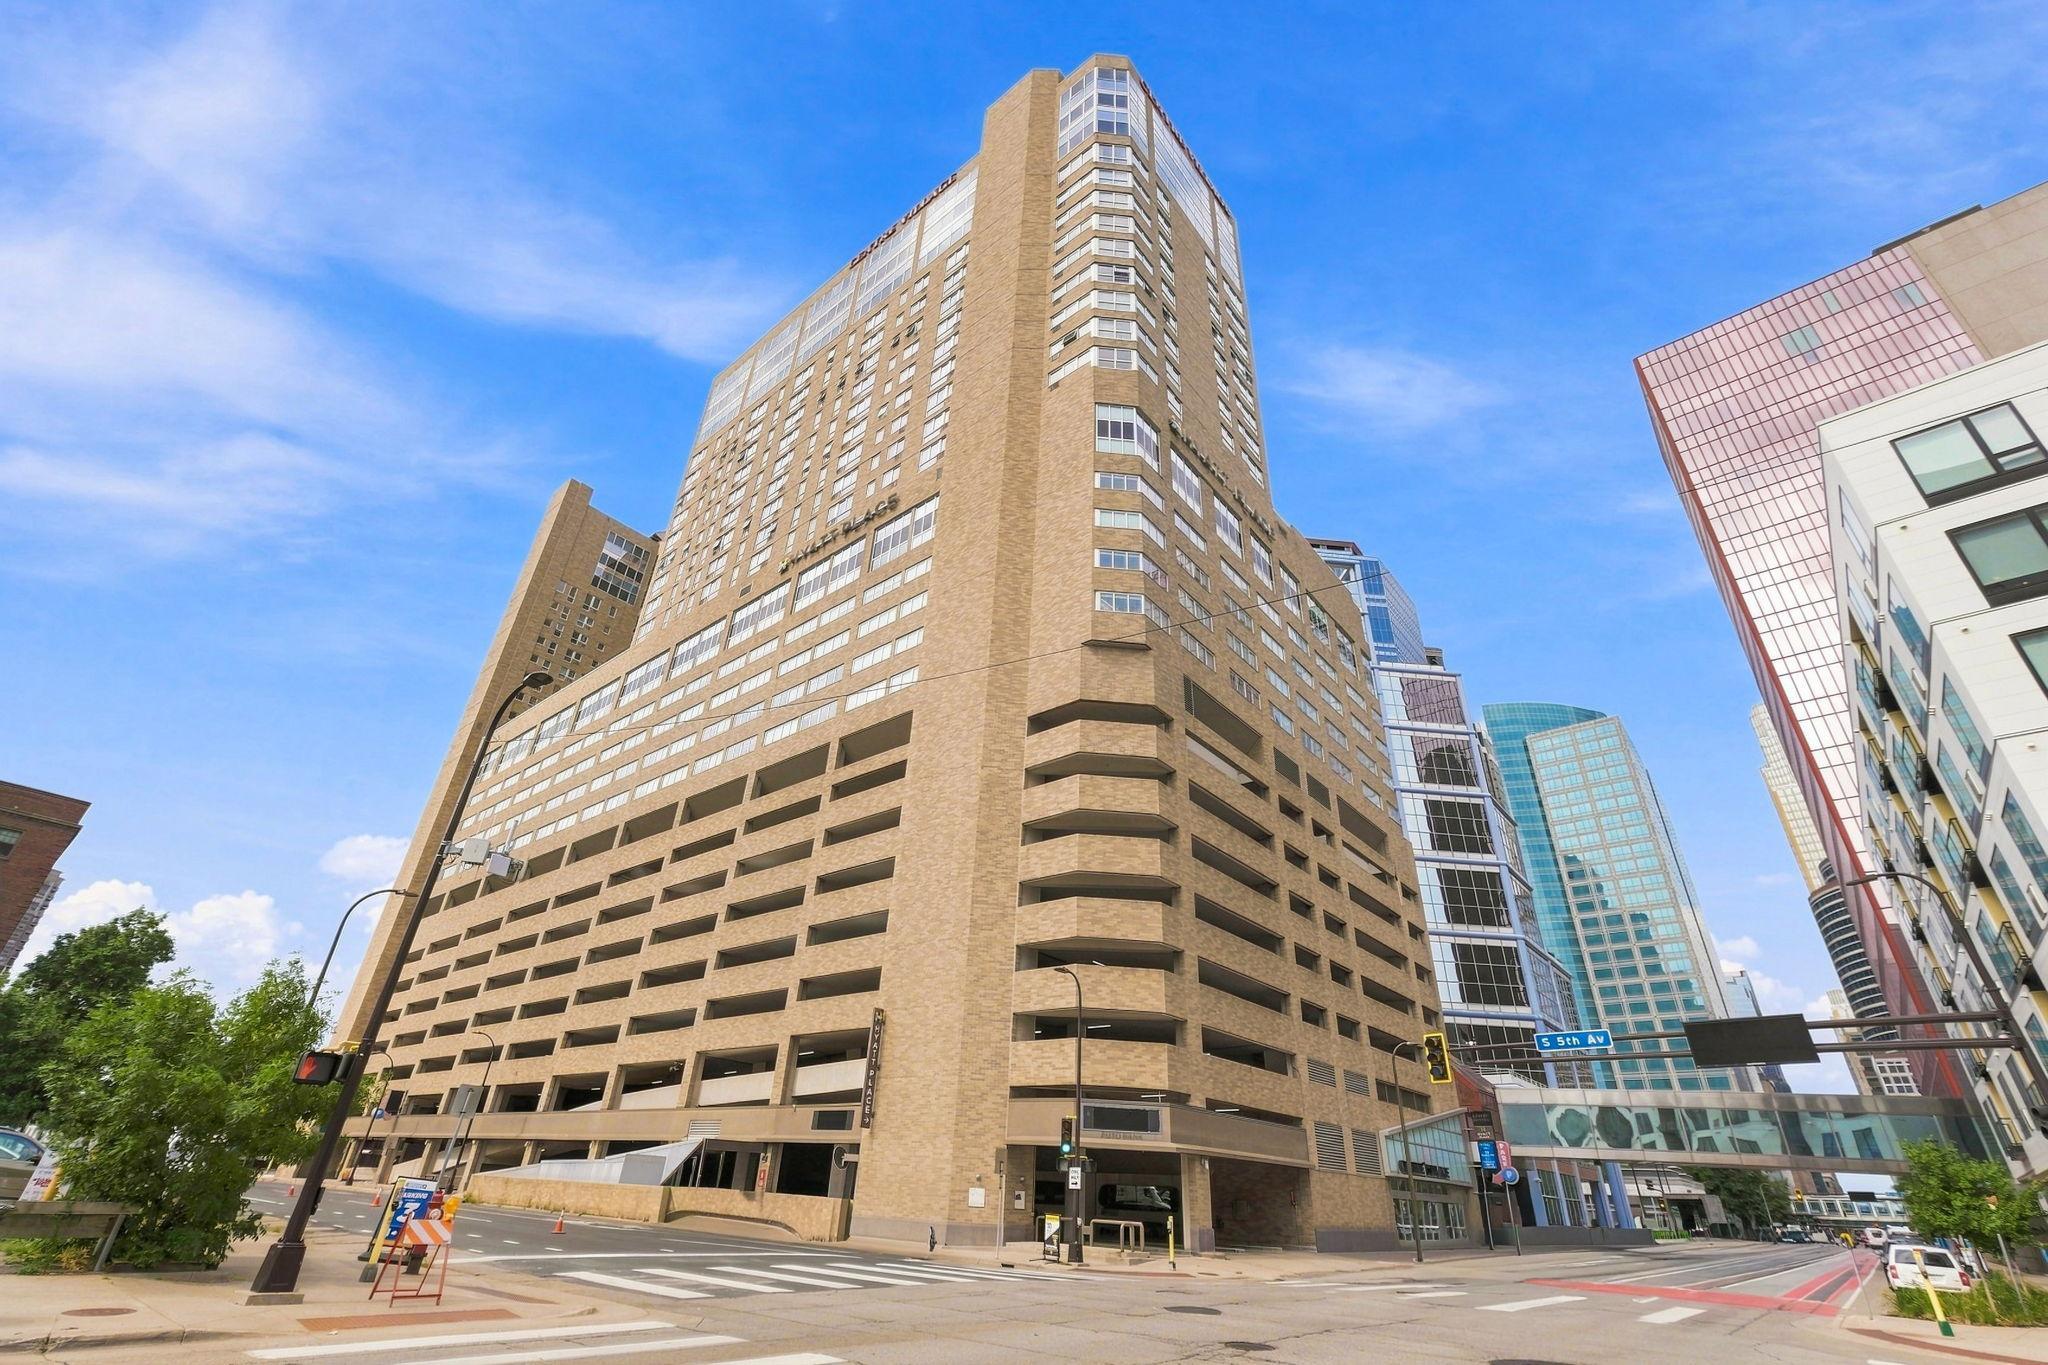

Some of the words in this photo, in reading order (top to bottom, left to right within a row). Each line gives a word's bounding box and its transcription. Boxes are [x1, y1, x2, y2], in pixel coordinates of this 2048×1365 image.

[842, 493, 899, 537] PLACE
[871, 1024, 881, 1066] HYATT
[1541, 1037, 1551, 1048] S
[1556, 1036, 1580, 1047] 5th
[1587, 1034, 1605, 1045] Av
[864, 1069, 875, 1115] PLACE
